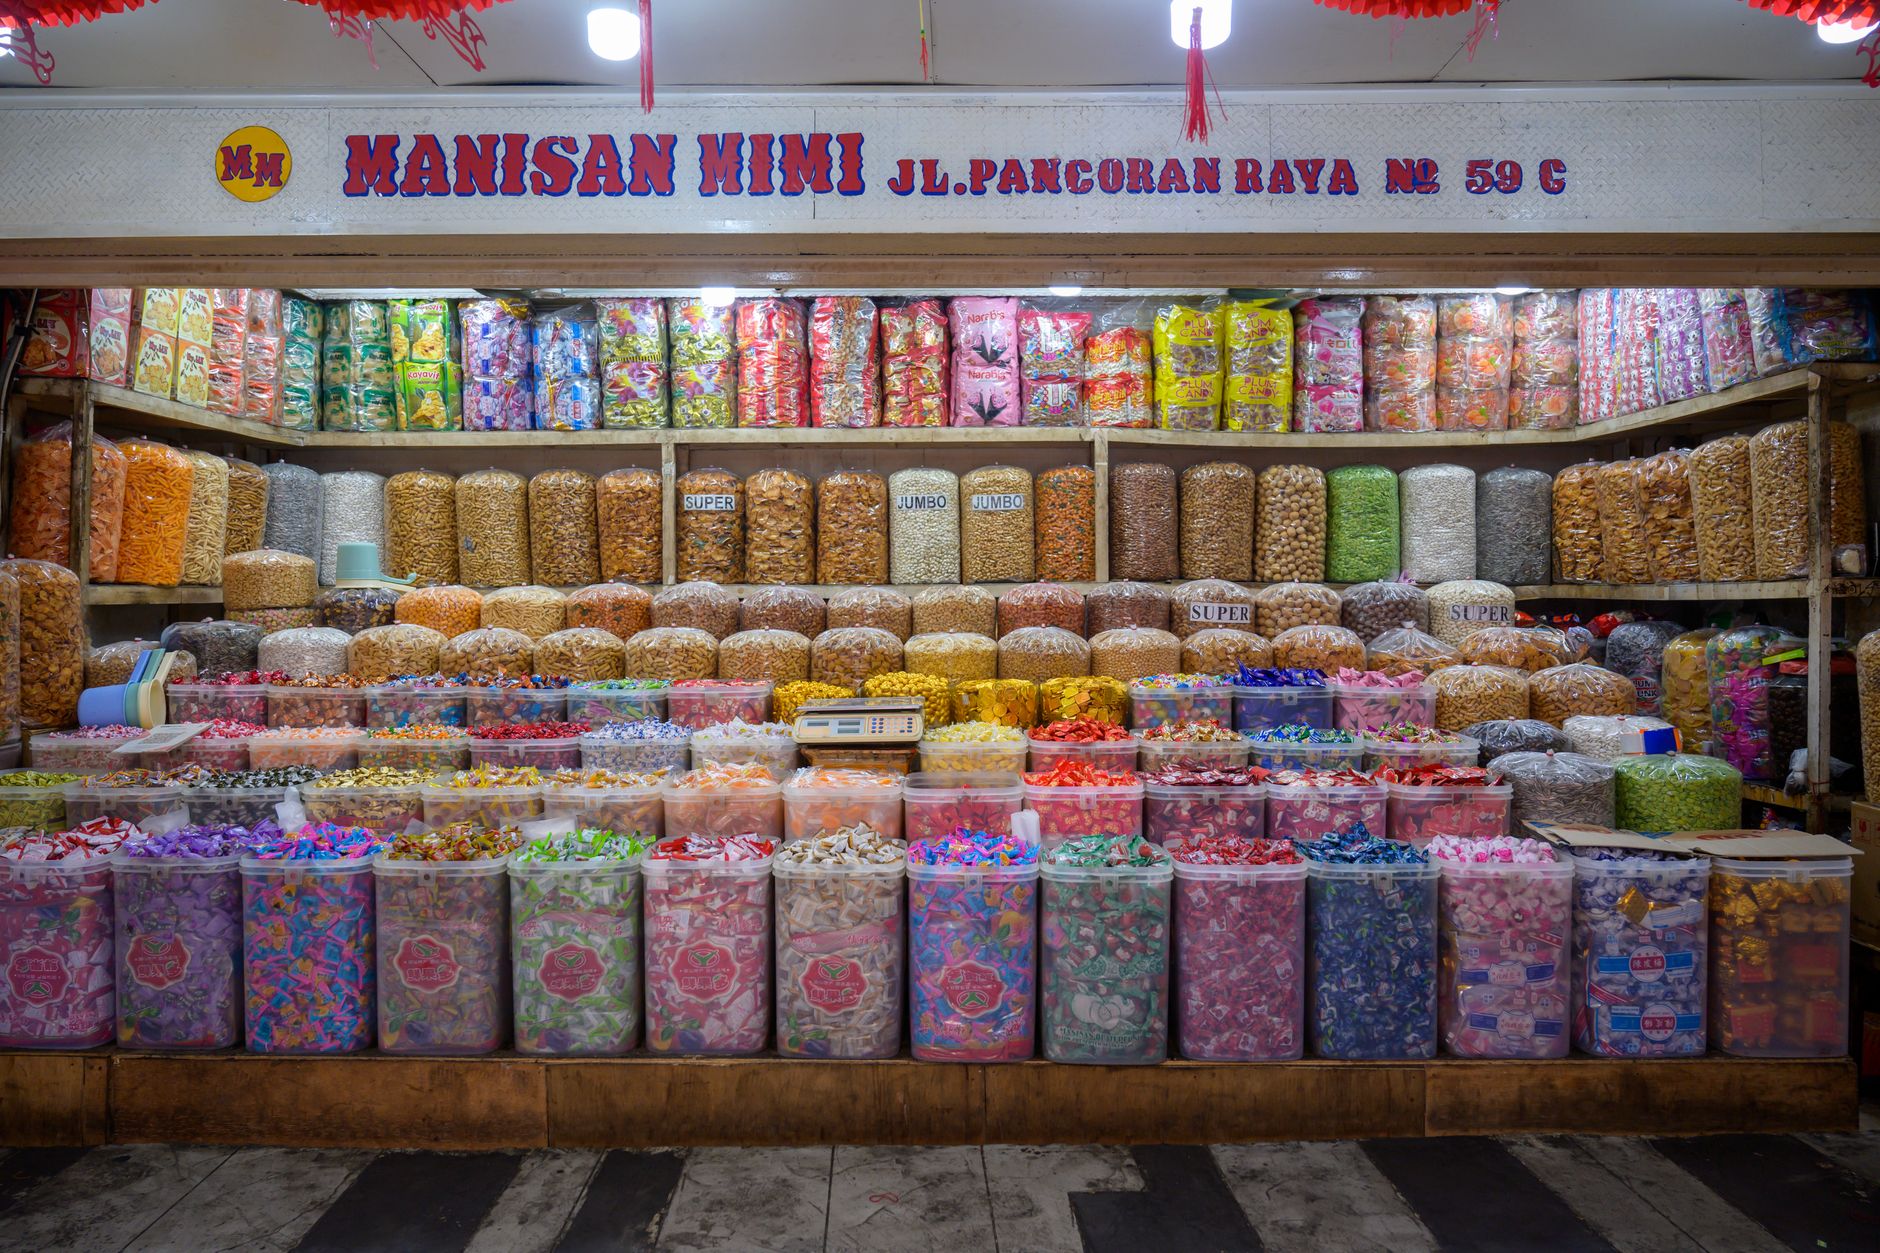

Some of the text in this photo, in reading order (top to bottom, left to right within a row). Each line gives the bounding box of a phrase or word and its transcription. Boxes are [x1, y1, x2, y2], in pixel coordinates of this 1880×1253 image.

[343, 133, 677, 197] MANISAN
[698, 132, 865, 197] MIMI
[1235, 158, 1359, 196] RAYA
[1465, 159, 1523, 195] 59
[1175, 388, 1214, 398] CANDY
[1238, 386, 1279, 398] CANDY
[685, 495, 734, 510] SUPER
[897, 495, 947, 510] JUMBO
[972, 495, 1022, 510] JUMBO
[1191, 604, 1250, 622] SUPER
[1450, 604, 1510, 622] SUPER
